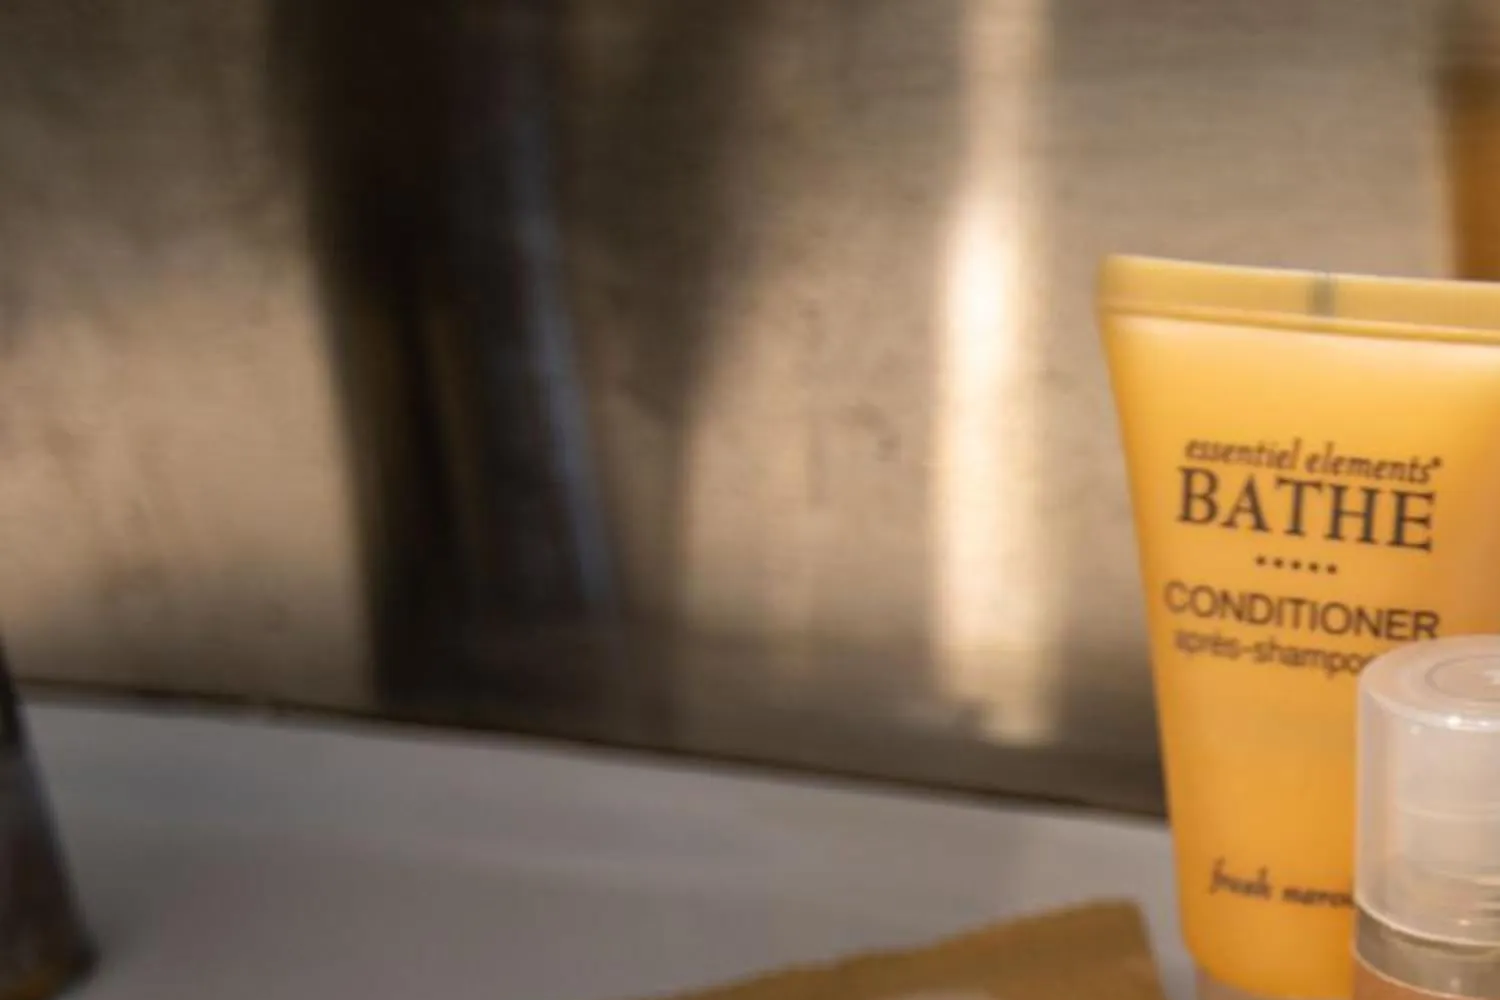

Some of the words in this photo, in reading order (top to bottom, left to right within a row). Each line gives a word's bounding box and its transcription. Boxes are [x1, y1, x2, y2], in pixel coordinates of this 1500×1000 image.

[1184, 437, 1298, 472] essentiel
[1175, 466, 1435, 553] BATHE
[1163, 581, 1441, 642] CONDITIONER
